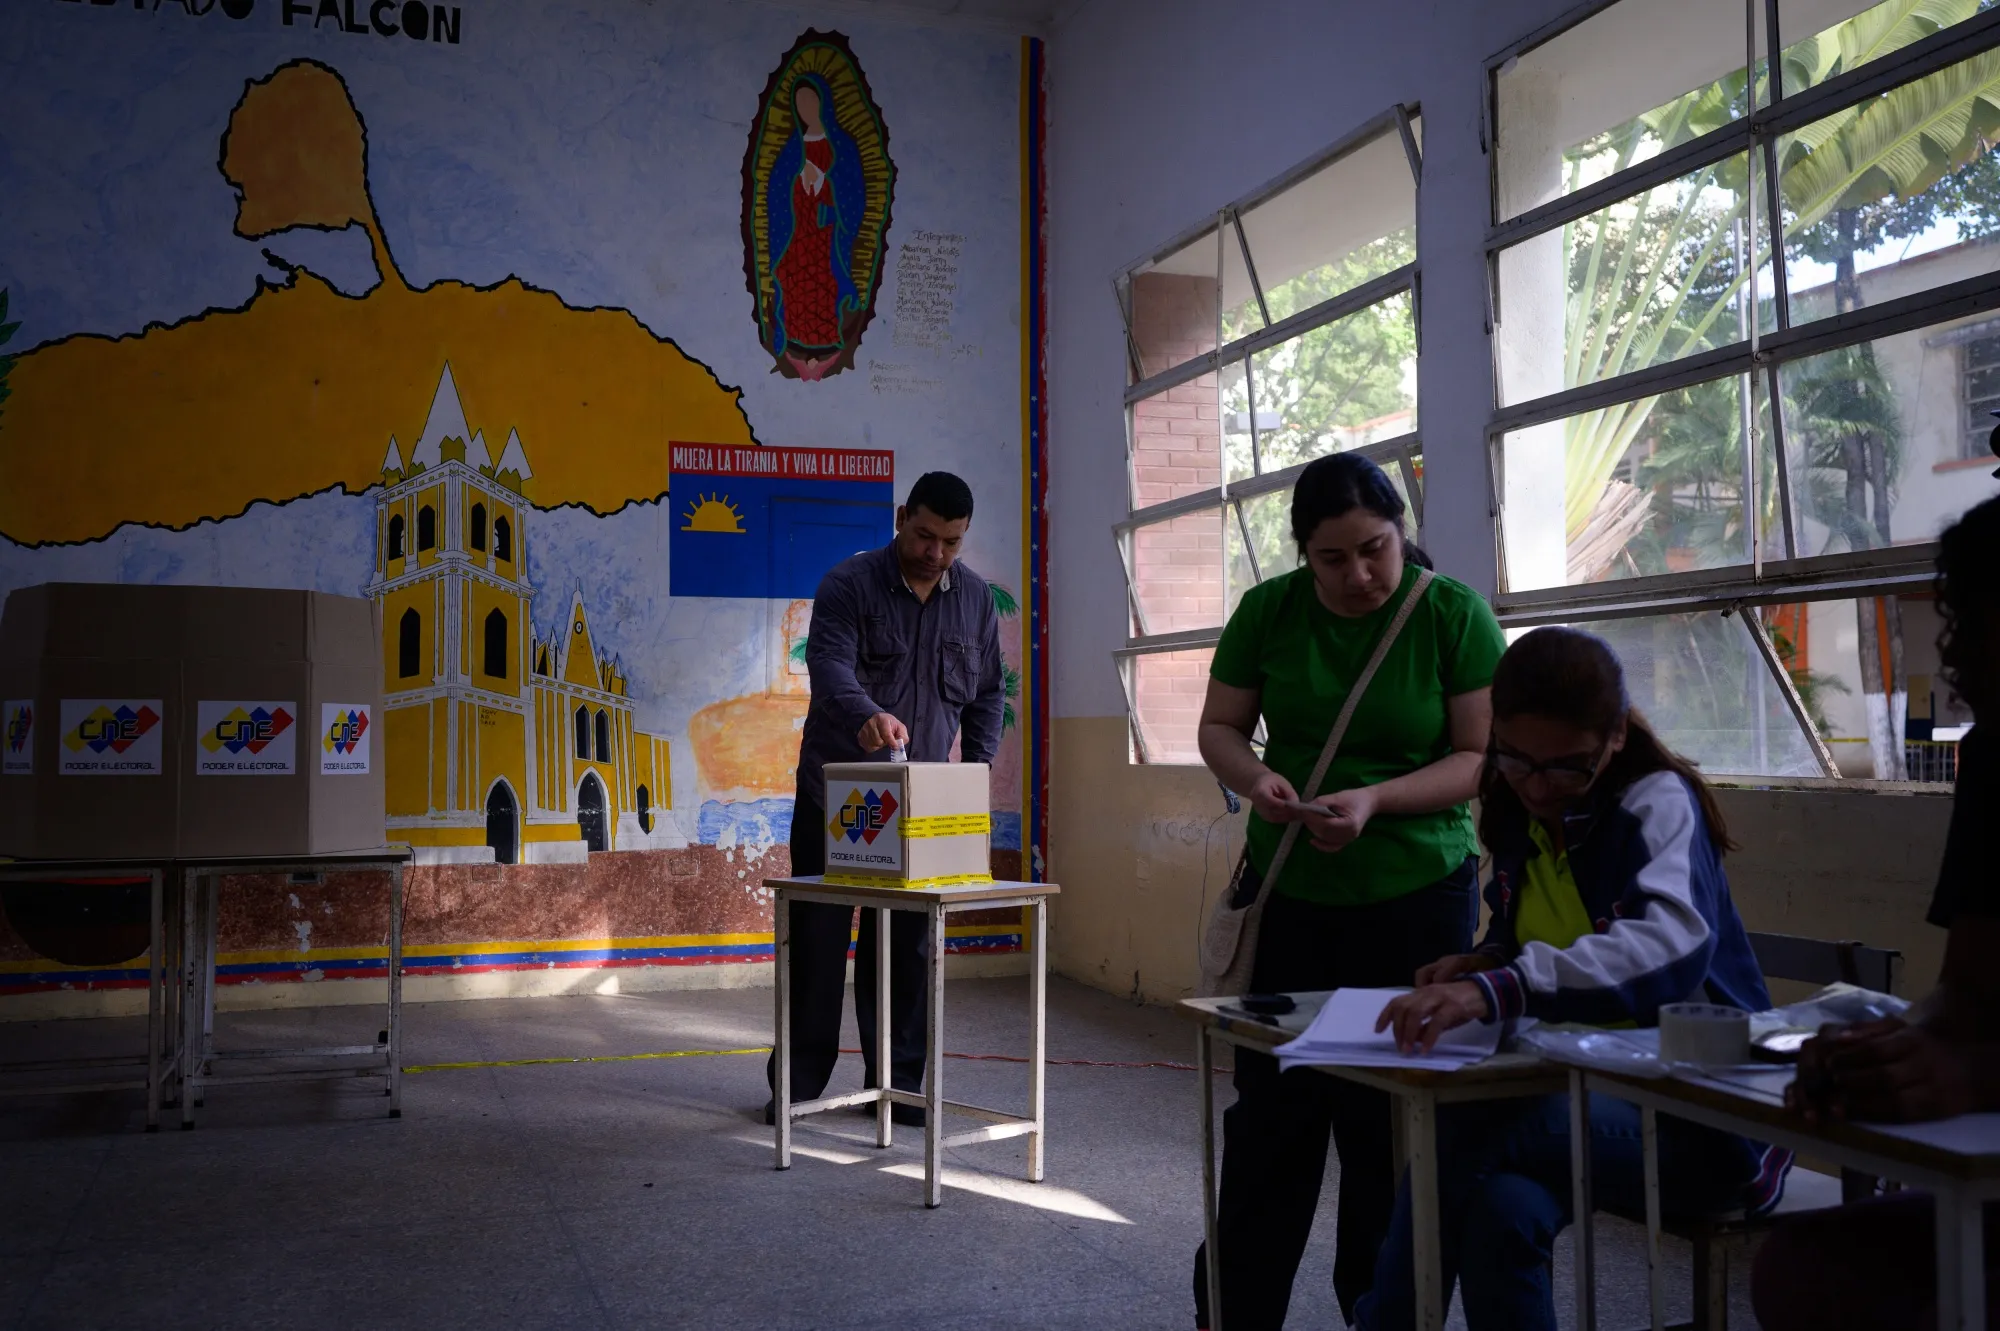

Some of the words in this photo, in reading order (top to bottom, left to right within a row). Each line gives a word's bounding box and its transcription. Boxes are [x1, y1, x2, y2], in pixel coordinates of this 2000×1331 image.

[282, 0, 461, 43] FALCON
[673, 447, 714, 471] MUERA
[717, 449, 731, 472] LA
[735, 450, 778, 473] TIRANIA
[782, 452, 789, 474] Y
[793, 453, 818, 475] VIVA
[821, 454, 835, 475] LA
[839, 455, 890, 477] LIBERTAD
[65, 762, 98, 770] PODER
[101, 762, 155, 770] ELECTORAL
[202, 762, 235, 770] PODER
[237, 762, 289, 770] ELECTORAL
[831, 852, 855, 861] PODER
[856, 853, 896, 864] ELECTORAL
